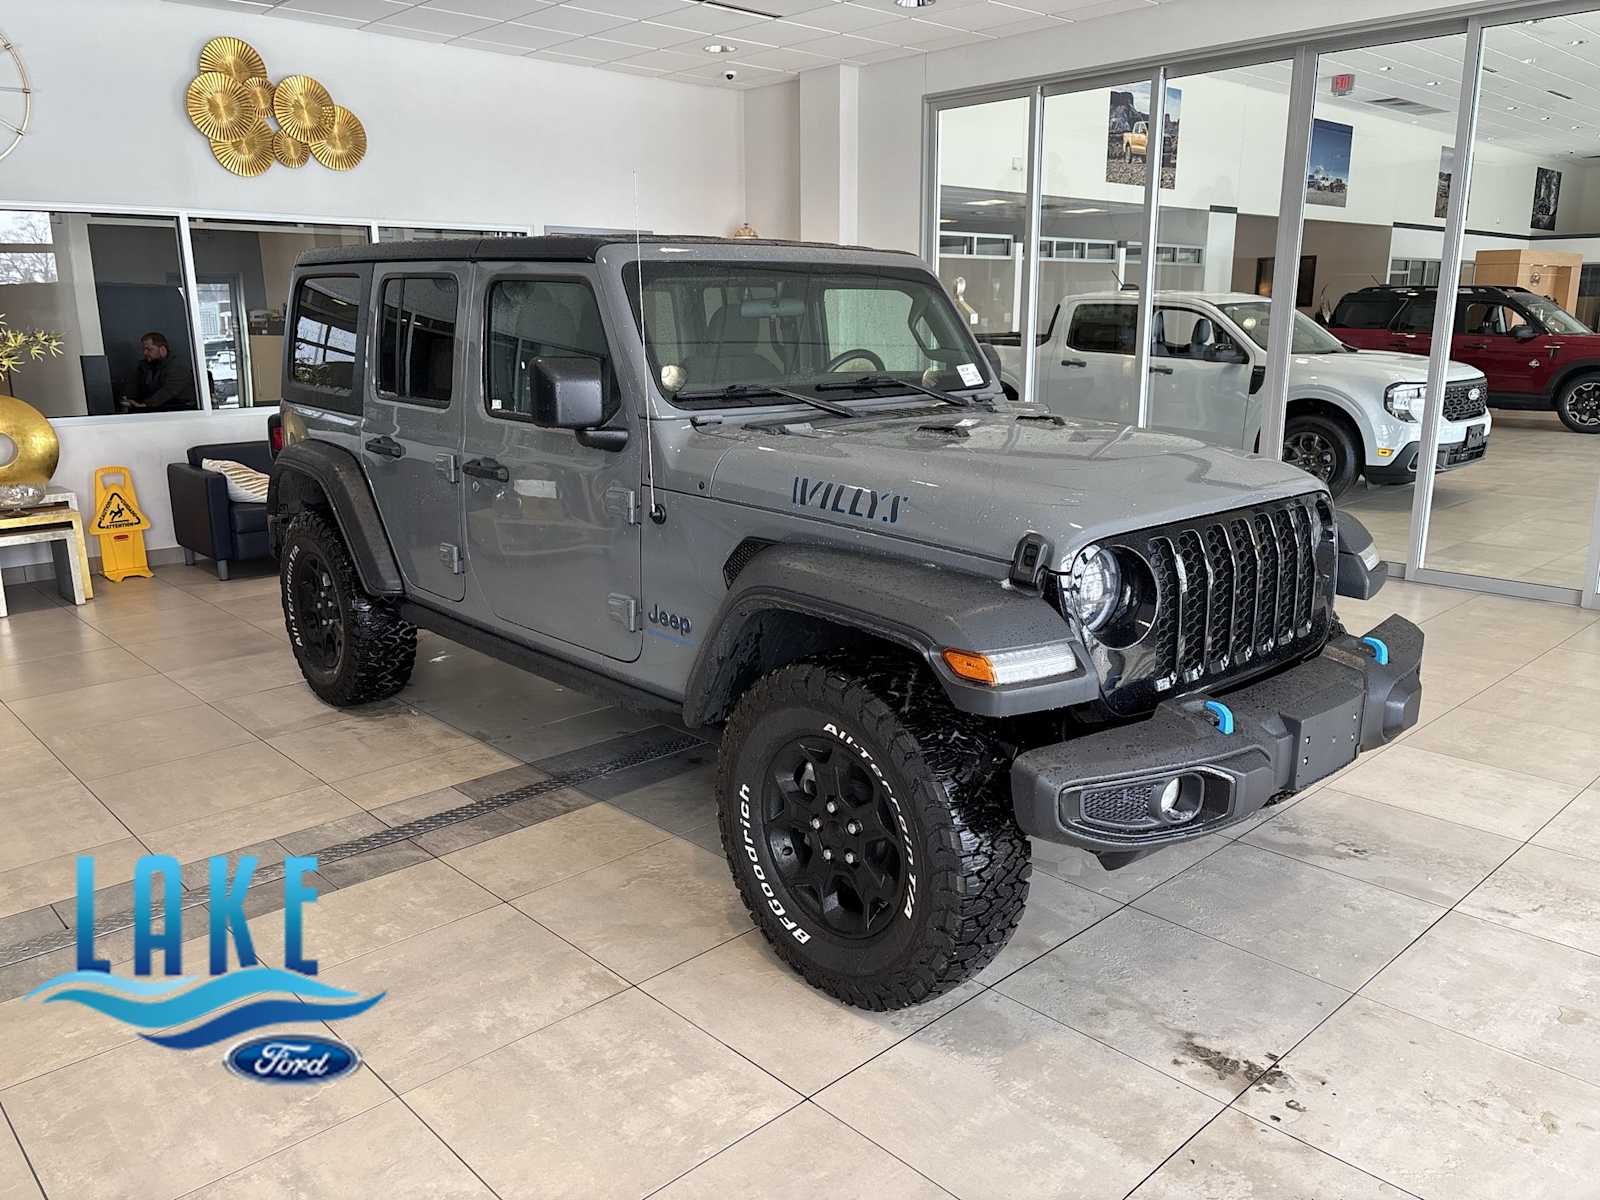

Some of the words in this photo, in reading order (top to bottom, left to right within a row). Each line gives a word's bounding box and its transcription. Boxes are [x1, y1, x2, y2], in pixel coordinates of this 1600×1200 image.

[648, 603, 692, 636] Jeep
[739, 783, 812, 945] BFGoodrich
[903, 872, 917, 920] T/A
